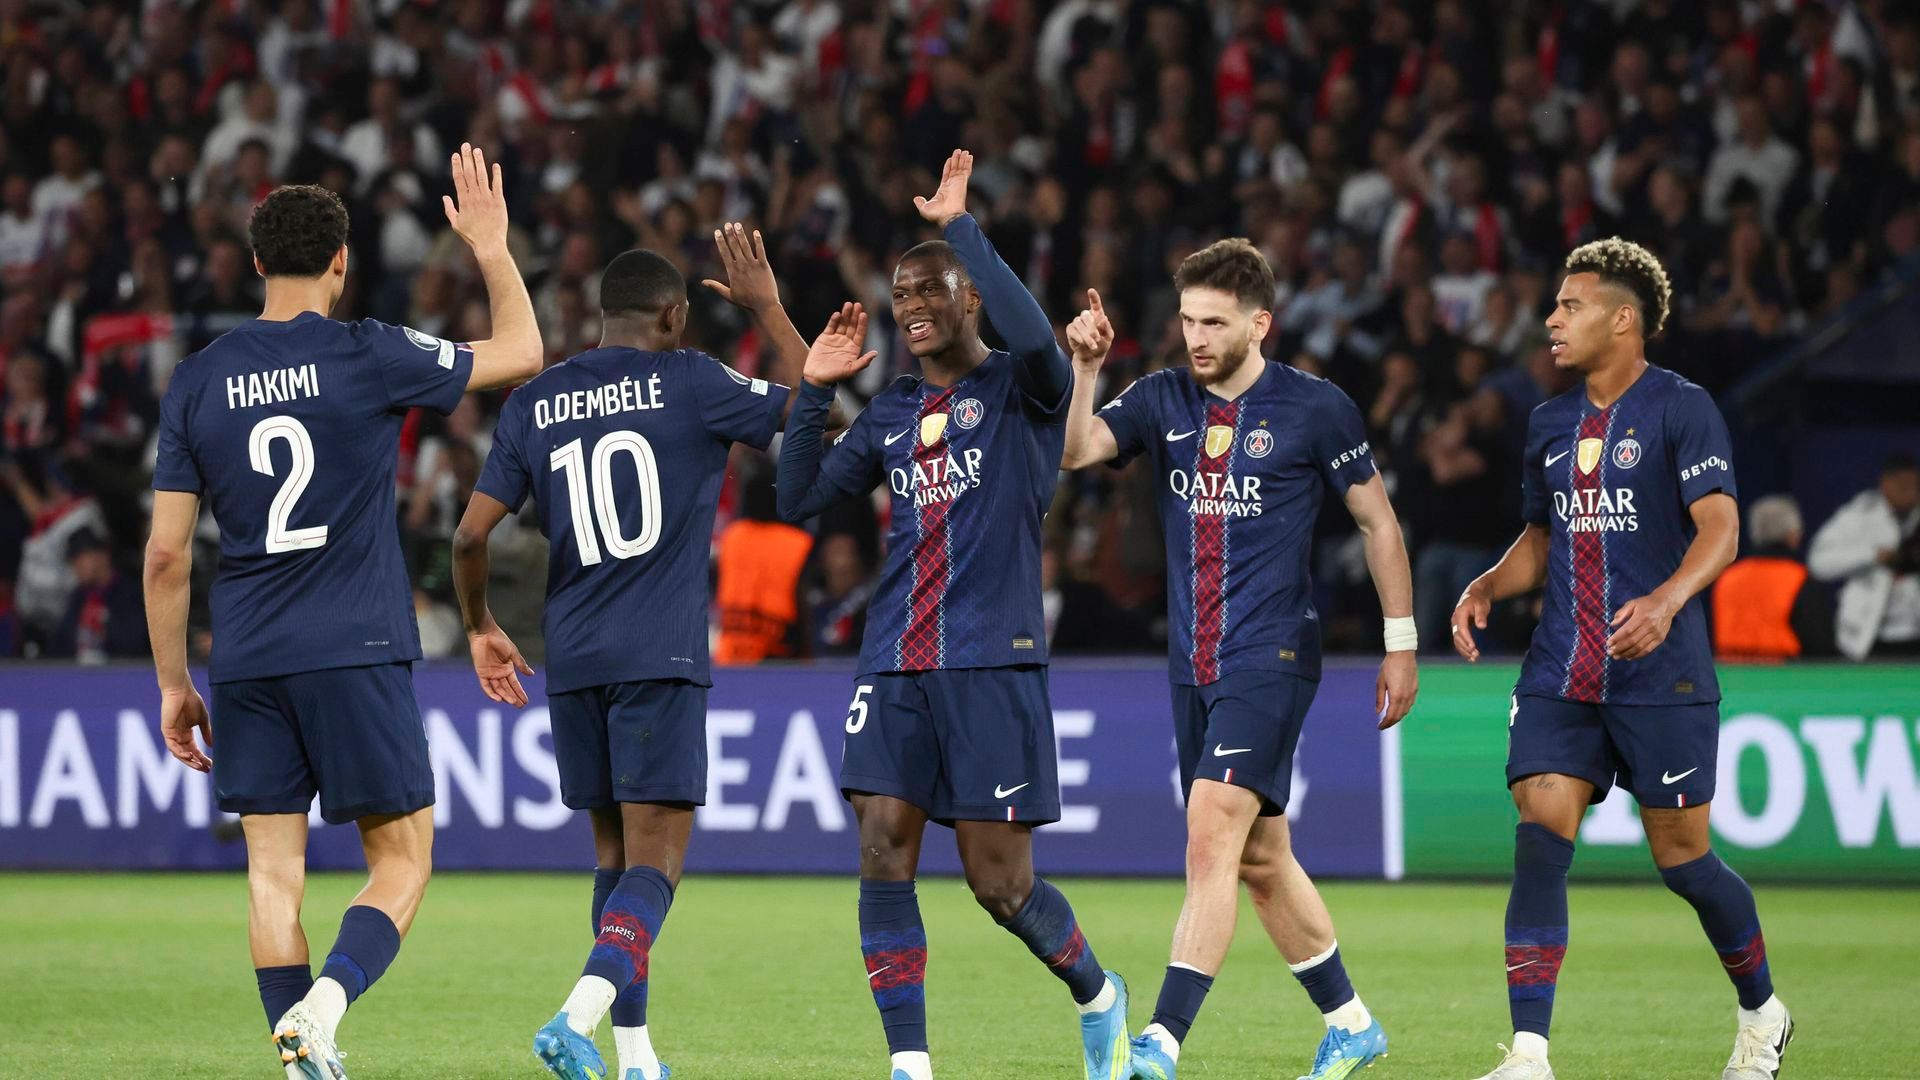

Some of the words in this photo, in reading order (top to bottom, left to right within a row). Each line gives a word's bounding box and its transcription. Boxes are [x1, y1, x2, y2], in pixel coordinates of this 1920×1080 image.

[226, 363, 320, 410] HAKIMI
[534, 373, 665, 430] O.DEMBÉLÉ
[248, 415, 329, 553] 2
[890, 448, 982, 499] QATAR
[1169, 468, 1262, 501] QATAR
[549, 430, 663, 567] 10
[1187, 498, 1263, 517] AIRWAYS
[1553, 487, 1637, 522] QATAR
[1566, 515, 1639, 532] AIRWAYS
[601, 925, 636, 941] PARIS
